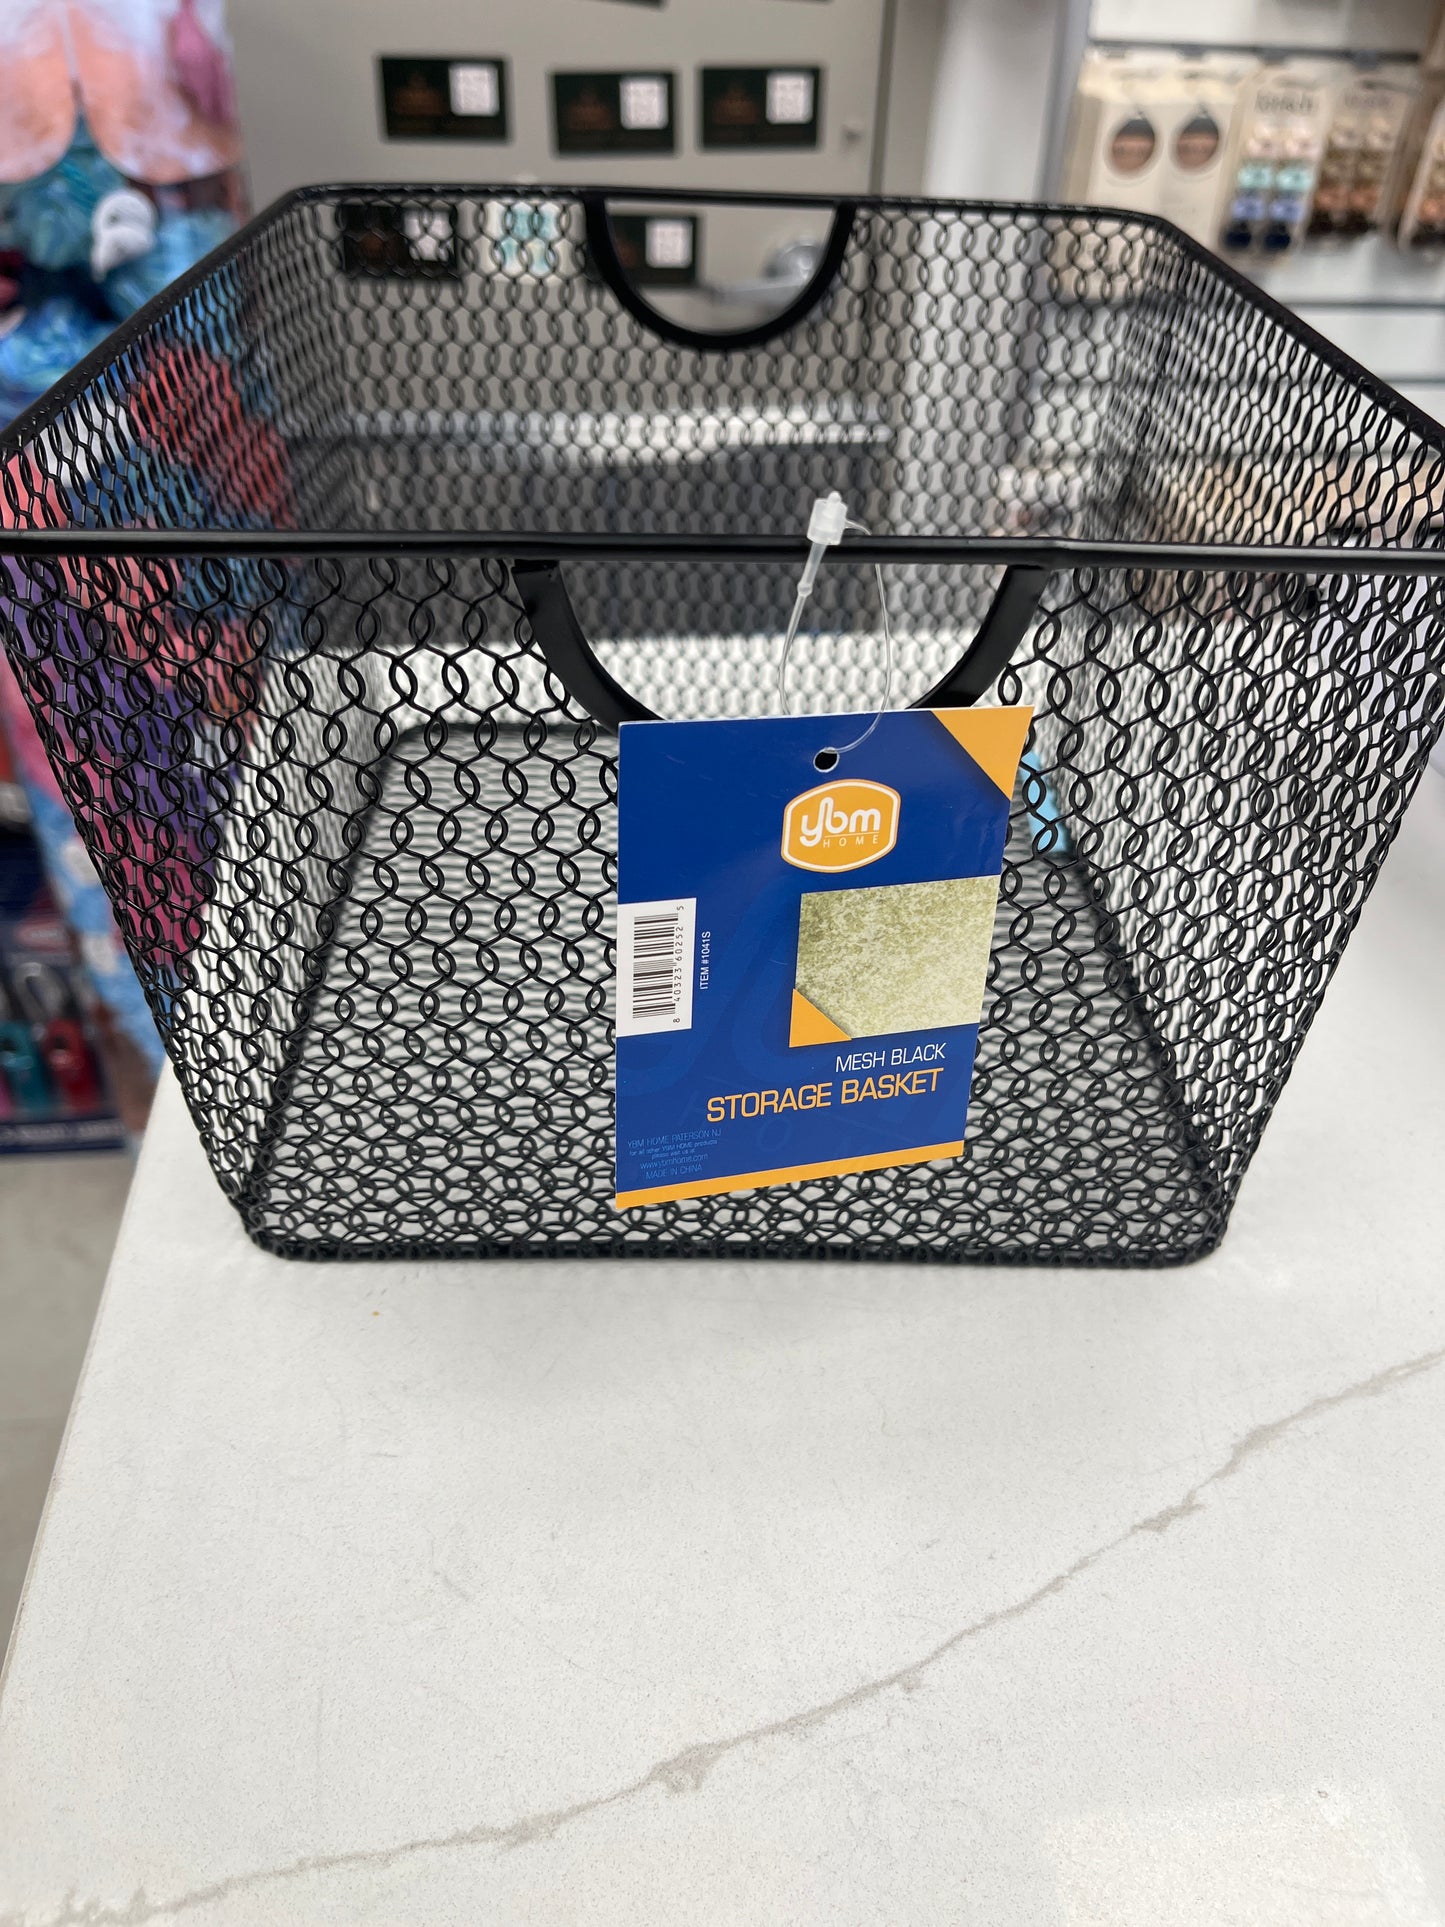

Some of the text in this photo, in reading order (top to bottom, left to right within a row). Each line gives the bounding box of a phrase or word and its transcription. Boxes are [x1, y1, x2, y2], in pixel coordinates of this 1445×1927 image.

[800, 796, 881, 847] ybm
[823, 834, 879, 848] HOME
[675, 927, 684, 962] 60252
[700, 931, 711, 990] ITEM #1041S
[674, 968, 682, 1002] 40323
[835, 1042, 947, 1073] MESH BLACK
[706, 1067, 944, 1123] STORAGE BASKET
[628, 1128, 721, 1149] YBM HOME PATERSON NJ
[646, 1169, 666, 1180] MADE
[680, 1164, 703, 1174] CHINA
